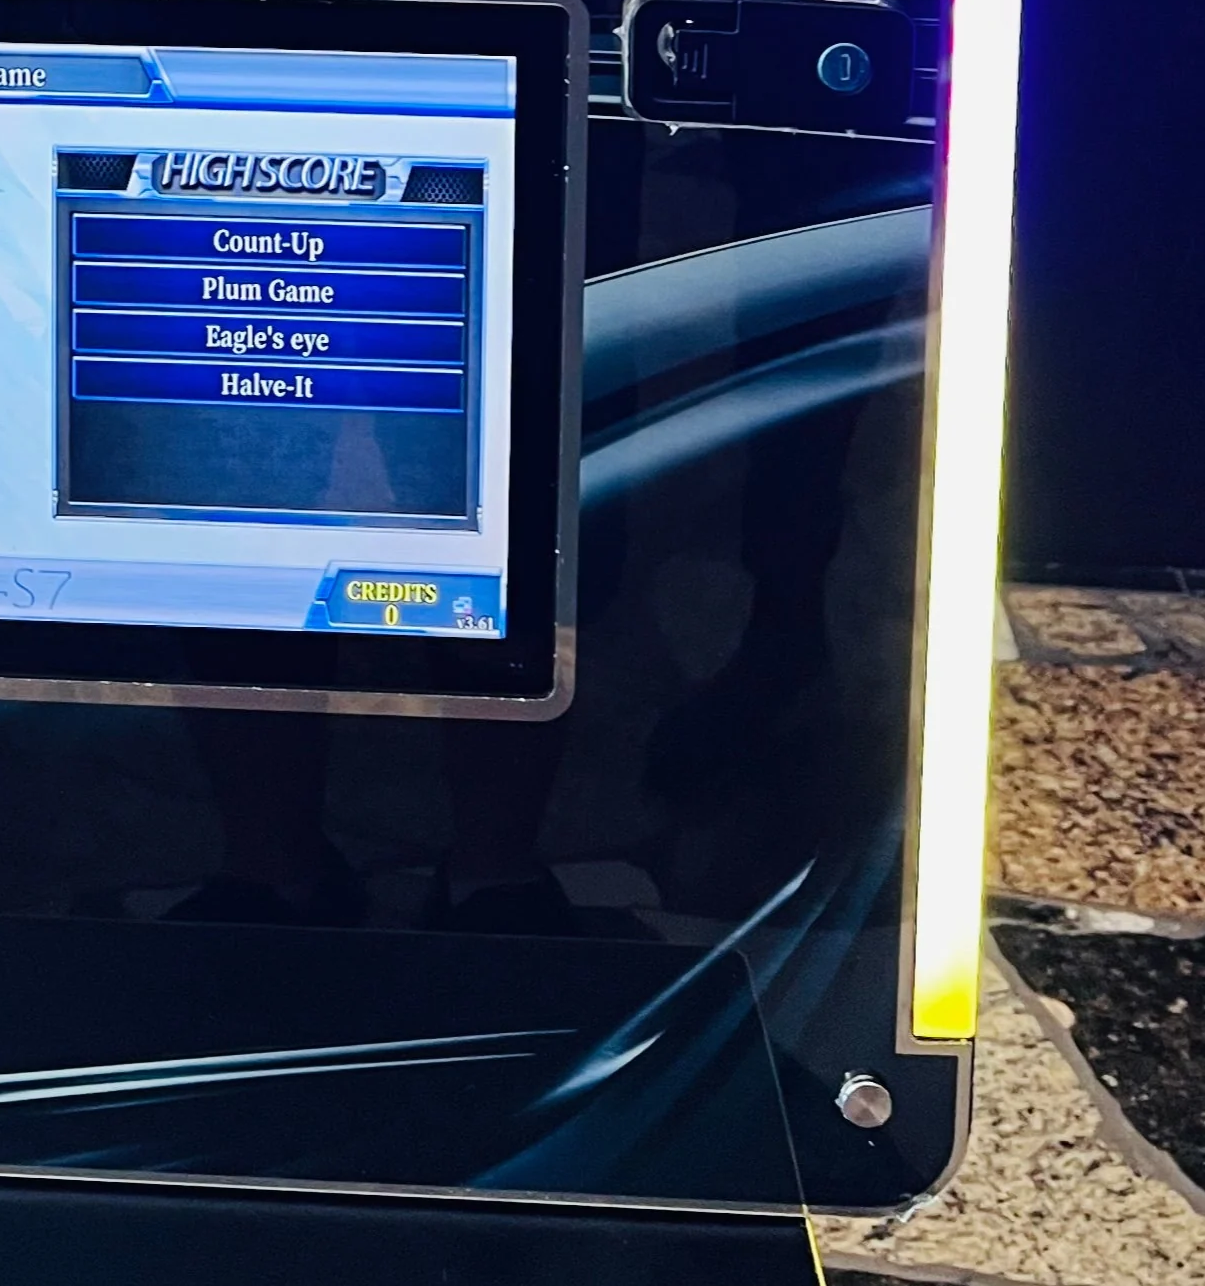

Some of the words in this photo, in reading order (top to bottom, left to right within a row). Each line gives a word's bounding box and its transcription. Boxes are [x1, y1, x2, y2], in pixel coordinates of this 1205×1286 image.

[213, 229, 325, 261] Count-Up
[202, 277, 262, 302] Plum
[268, 279, 334, 305] Game
[206, 325, 286, 355] Eagle's
[290, 334, 330, 358] eye
[221, 373, 314, 399] Halve-It
[346, 580, 438, 604] CREDITS
[384, 603, 400, 626] 0
[456, 615, 495, 631] v3.61
